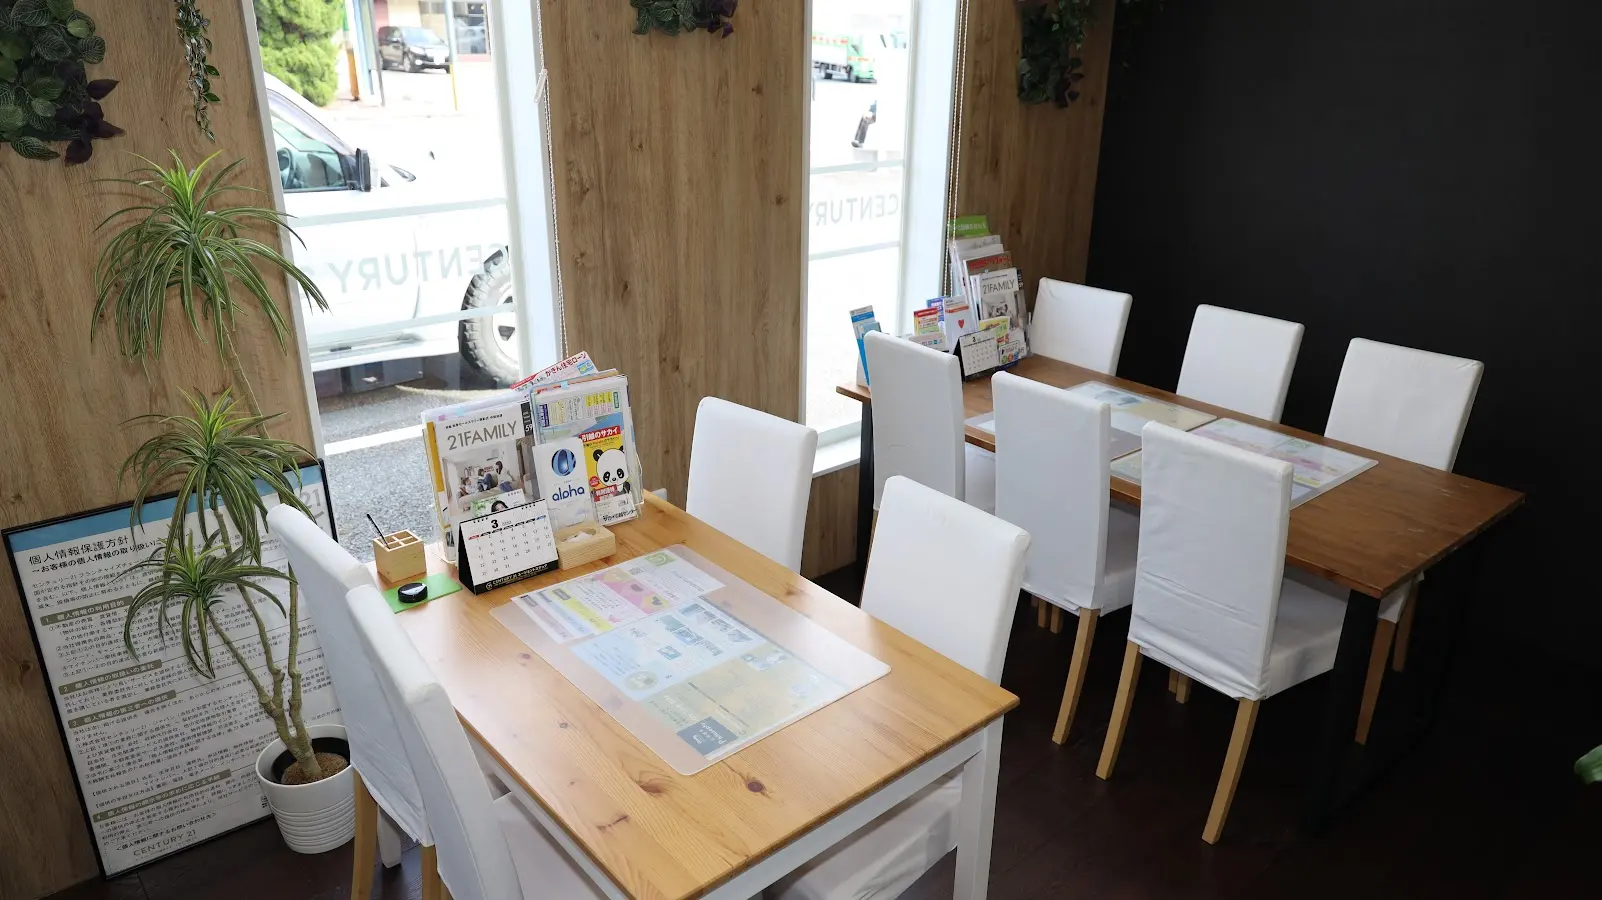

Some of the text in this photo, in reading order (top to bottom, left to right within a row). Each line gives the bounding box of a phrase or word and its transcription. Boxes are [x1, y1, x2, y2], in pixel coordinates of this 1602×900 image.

[983, 279, 1015, 295] 21FAMILY
[447, 420, 517, 451] 21FAMILY
[581, 427, 618, 442] 引越のサカイ
[552, 484, 585, 502] alpha
[491, 519, 499, 529] 3
[27, 533, 129, 567] 個人情報保護方針
[133, 833, 184, 857] CENTURY
[186, 828, 196, 836] 21
